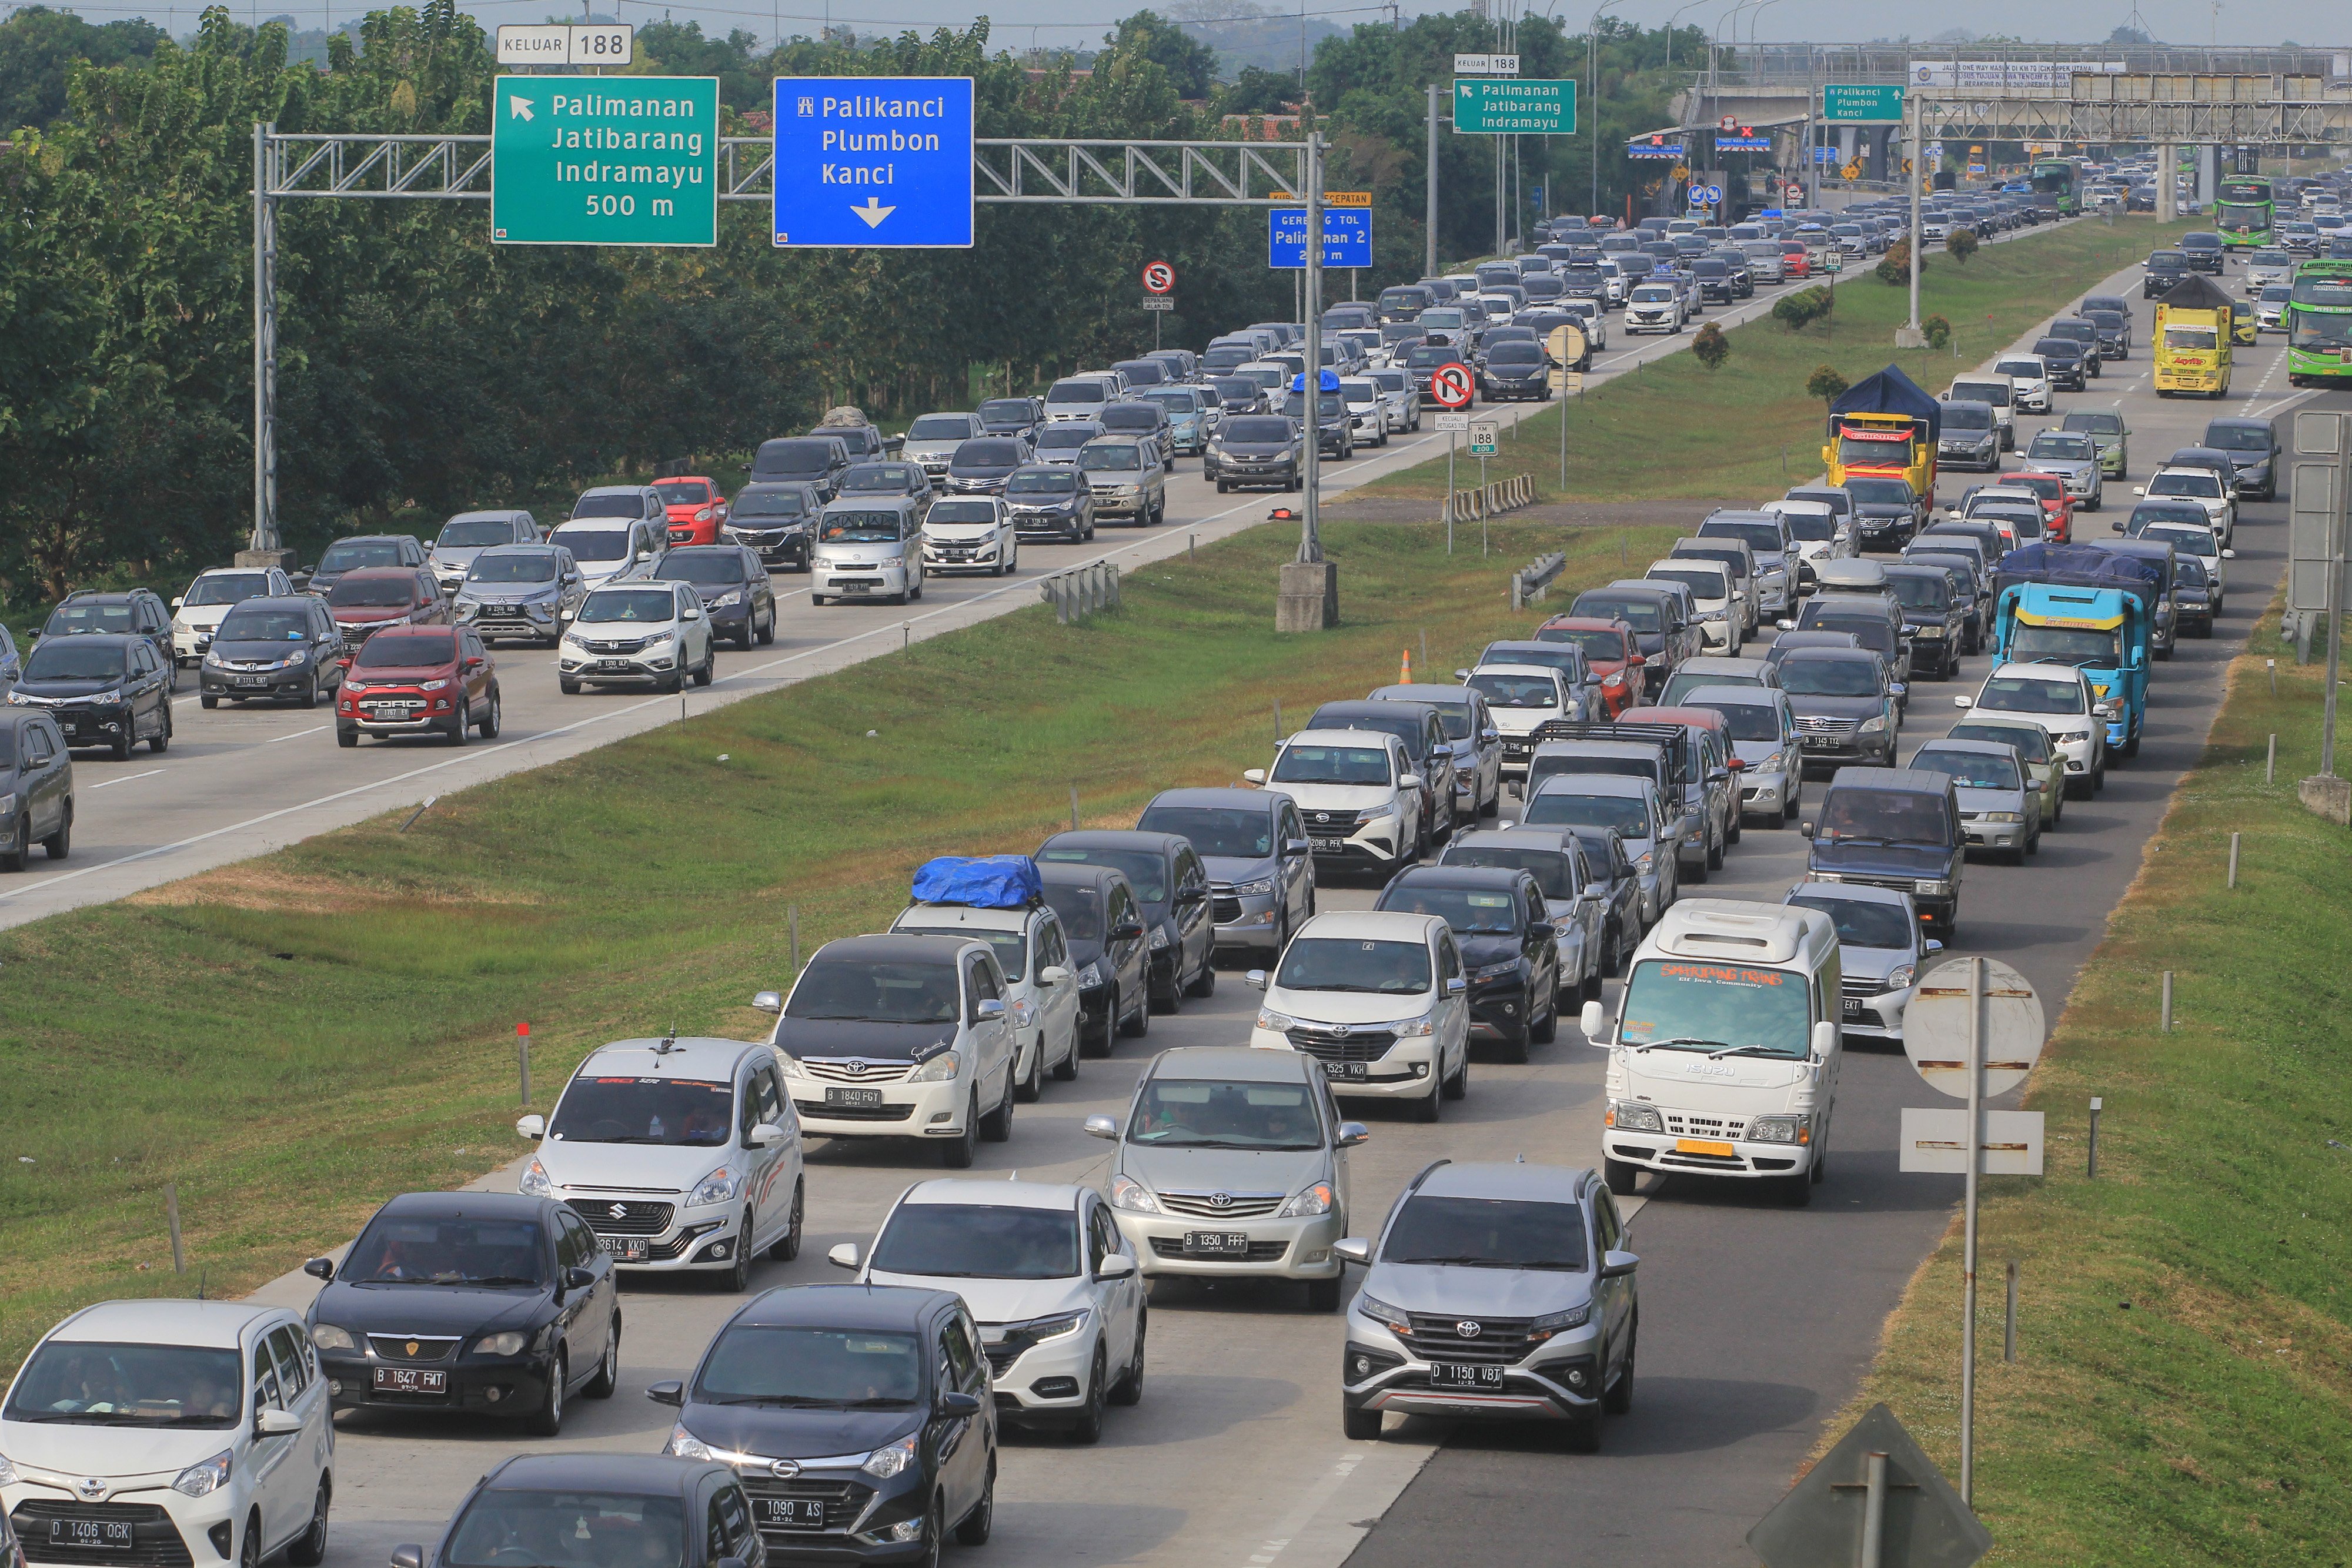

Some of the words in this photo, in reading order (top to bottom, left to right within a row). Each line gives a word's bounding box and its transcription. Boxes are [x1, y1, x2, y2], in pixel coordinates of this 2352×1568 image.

[505, 39, 562, 51] KELUAR
[581, 35, 623, 55] 188
[1495, 59, 1515, 68] 188
[1483, 85, 1559, 95] Palimanan
[553, 95, 694, 117] Palimanan
[823, 96, 943, 118] Palikanci
[1483, 101, 1561, 115] Jatibarang
[1483, 117, 1558, 130] Indramayu
[552, 128, 702, 156] Jatibarang
[823, 129, 939, 151] Plumbon
[556, 161, 702, 188] Indramayu
[823, 163, 894, 184] Kanci
[587, 196, 635, 216] 500
[653, 199, 673, 216] m
[1339, 216, 1359, 225] TOL
[1356, 230, 1365, 243] 2
[1331, 252, 1342, 260] m
[1474, 434, 1492, 443] 188
[358, 700, 427, 708] FORD
[1311, 839, 1326, 847] 2080
[1329, 840, 1341, 848] PFK
[1716, 979, 1763, 989] Community
[1739, 969, 1783, 986] TRANS
[1845, 1001, 1859, 1010] EKT
[1327, 1064, 1344, 1074] 1525
[1350, 1065, 1364, 1075] VKH
[1686, 1063, 1735, 1077] ISUZU
[828, 1090, 833, 1100] B
[841, 1090, 860, 1101] 1840
[863, 1091, 878, 1102] FGY
[628, 1239, 645, 1251] KKD
[1186, 1234, 1192, 1245] B
[1200, 1234, 1220, 1245] 1350
[1228, 1235, 1245, 1246] FFF
[377, 1370, 384, 1382] B
[393, 1370, 416, 1384] 1647
[1434, 1365, 1440, 1377] D
[1450, 1366, 1474, 1379] 1150
[767, 1500, 793, 1515] 1090
[806, 1503, 820, 1516] AS
[52, 1522, 59, 1535] D
[71, 1523, 98, 1537] 1406
[107, 1524, 129, 1539] QGK
